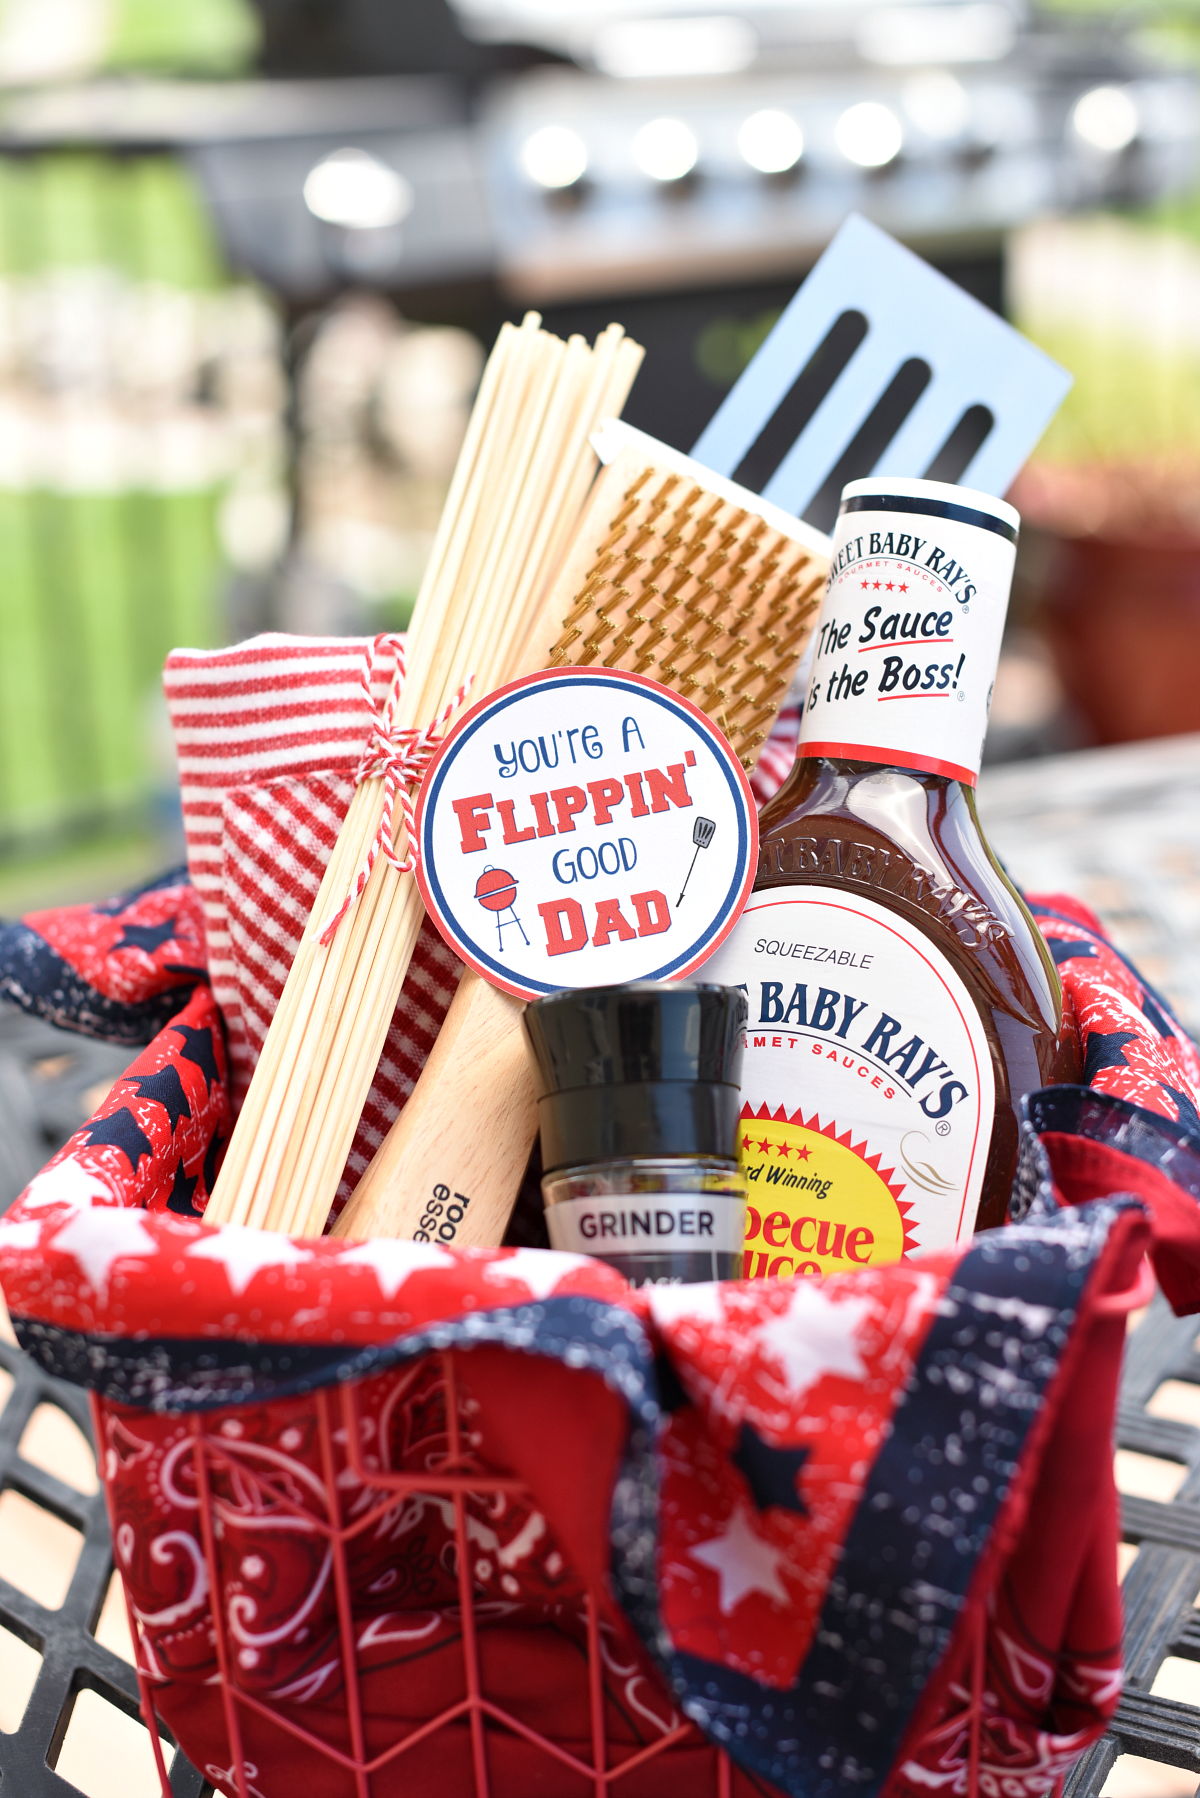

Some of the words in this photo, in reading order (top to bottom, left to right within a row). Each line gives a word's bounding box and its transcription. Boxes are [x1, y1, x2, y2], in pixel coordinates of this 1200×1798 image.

[838, 560, 890, 584] GOURMET
[896, 562, 943, 593] SAUCES
[869, 532, 928, 561] BABY
[924, 546, 978, 605] RAY'S
[817, 618, 852, 659] The
[858, 605, 954, 644] Sauce
[806, 676, 821, 713] is
[826, 663, 869, 703] the
[877, 653, 966, 693] Boss!
[622, 716, 646, 753] A
[451, 750, 698, 855] FLIPPIN'
[552, 837, 638, 885] GOOD
[537, 889, 673, 958] DAD
[753, 938, 875, 970] SQUEEZABLE
[758, 981, 869, 1040] BABY
[861, 1012, 970, 1119] RAY'S
[811, 1043, 896, 1100] SAUCES
[765, 1164, 834, 1200] Winning
[434, 1192, 471, 1248] roo
[578, 1210, 715, 1240] GRINDER
